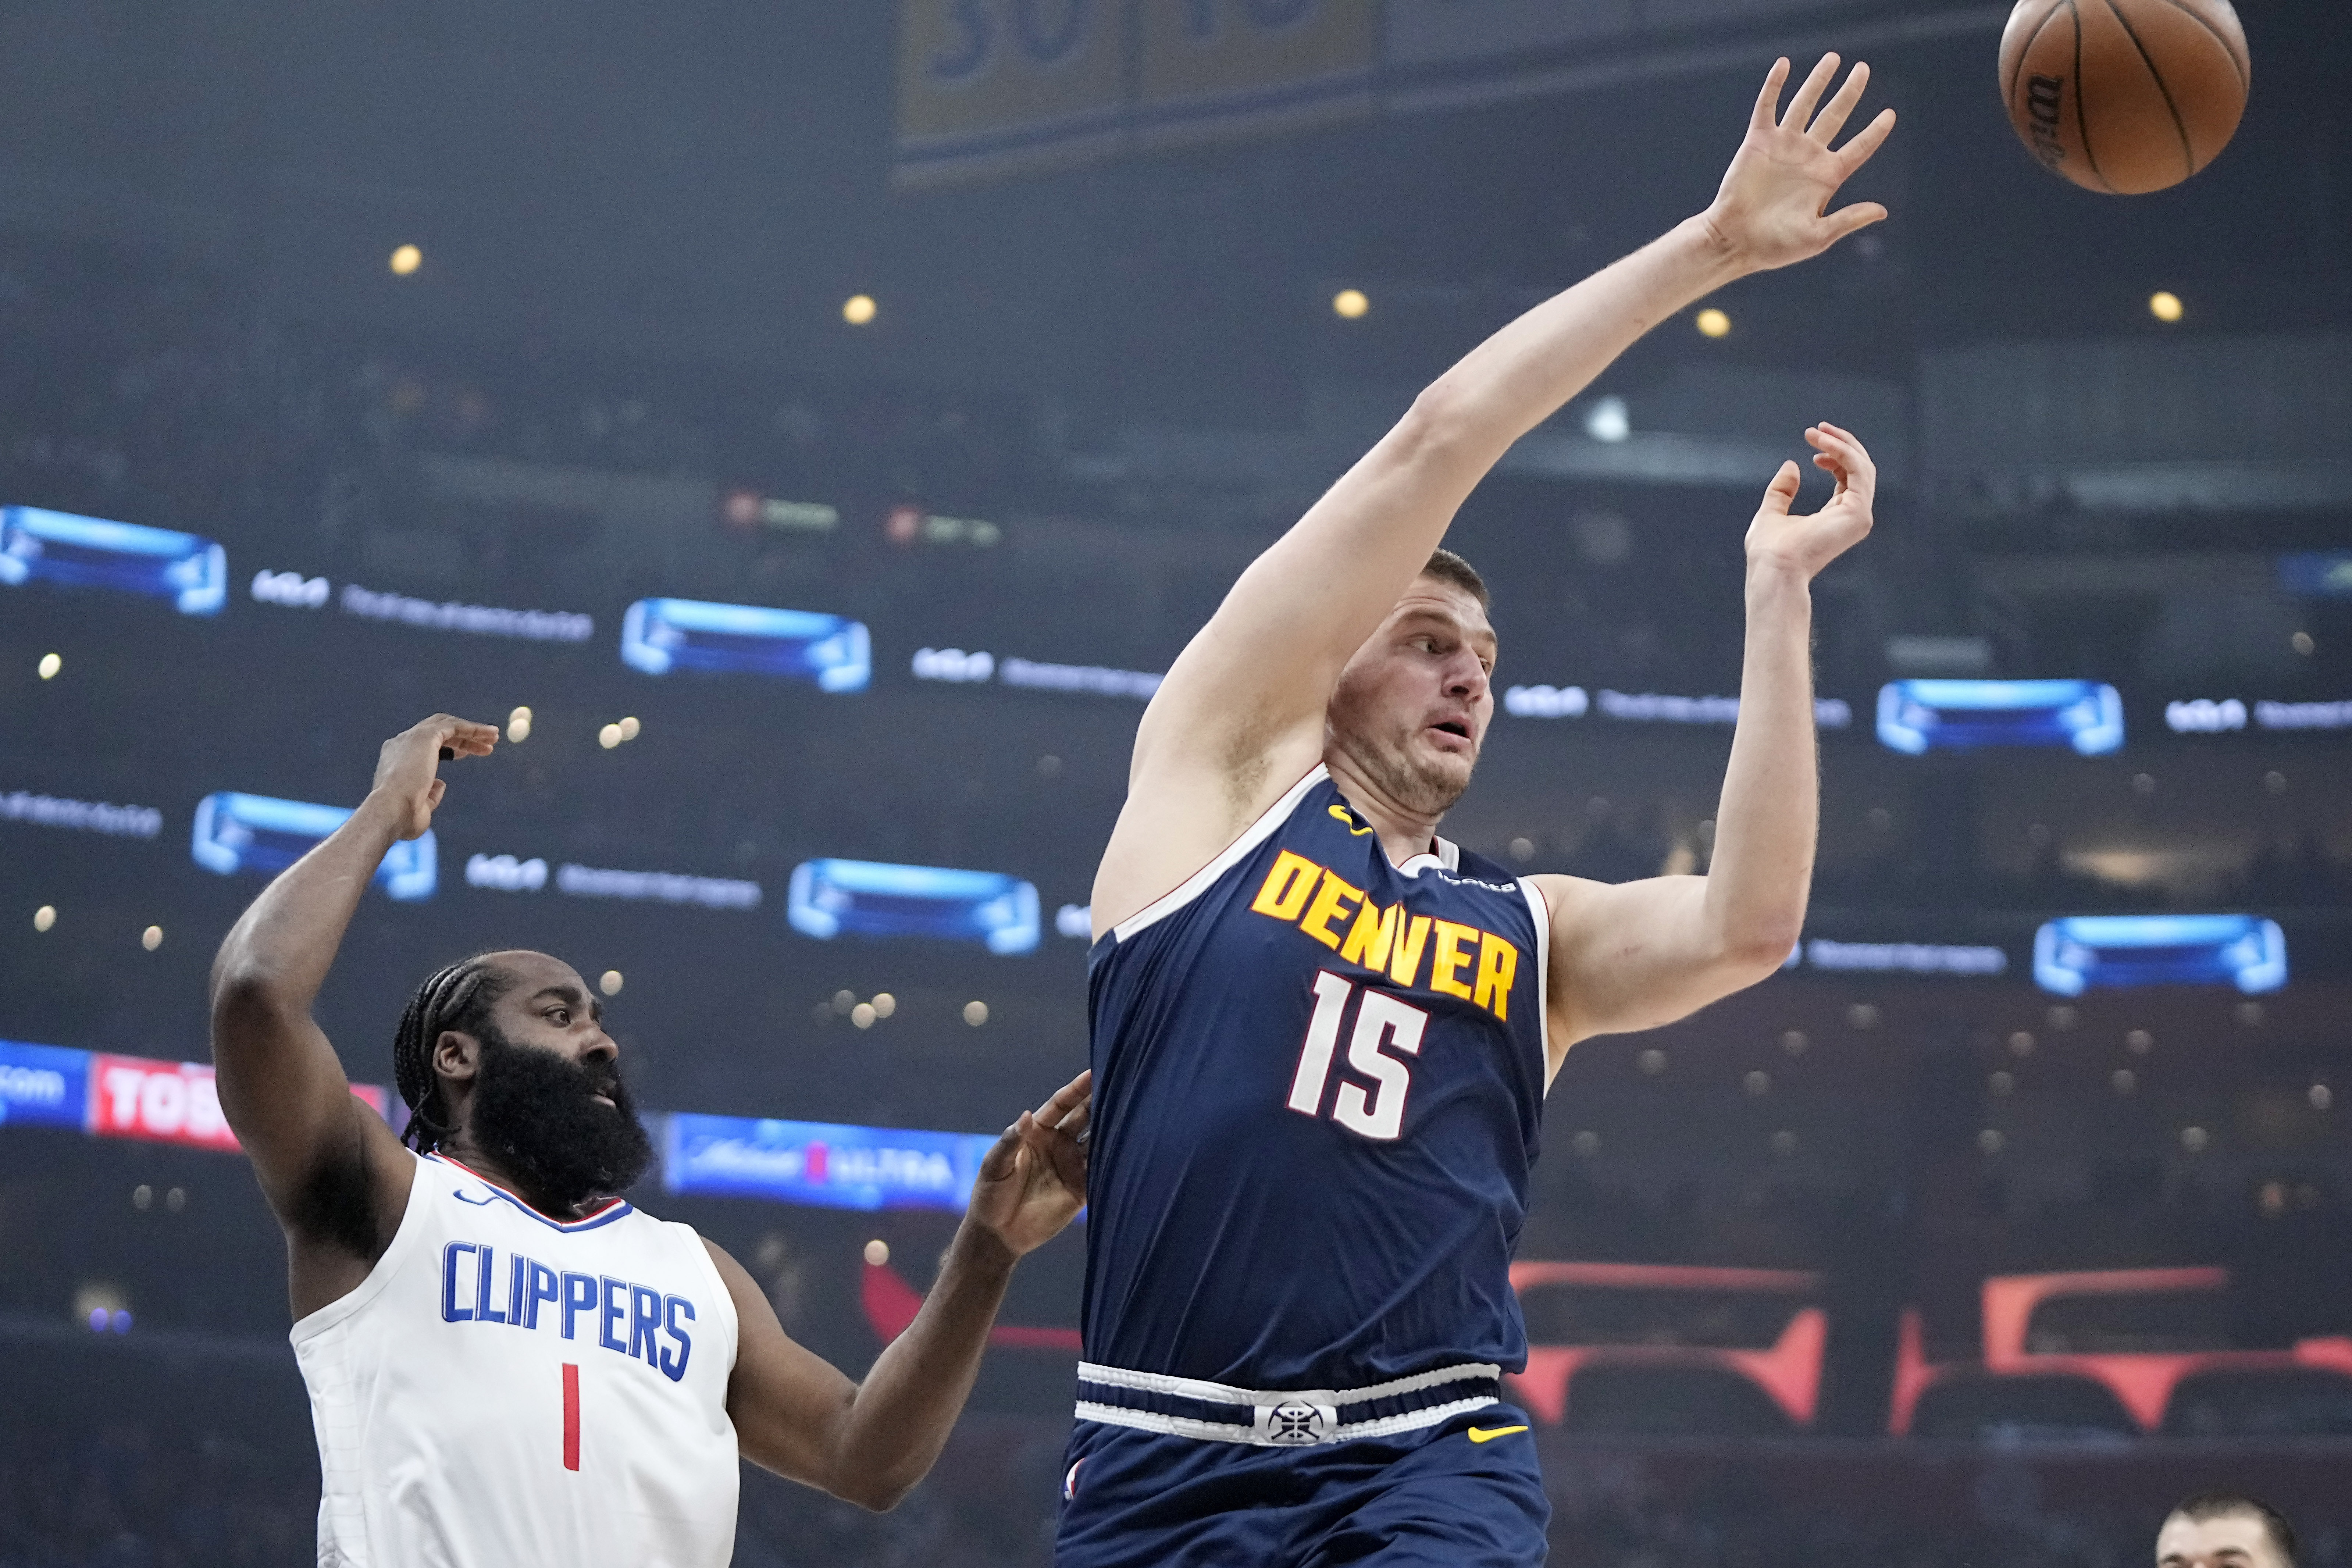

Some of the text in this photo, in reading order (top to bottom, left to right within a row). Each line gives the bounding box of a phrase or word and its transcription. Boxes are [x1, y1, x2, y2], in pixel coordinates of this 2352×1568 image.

[1251, 849, 1518, 1022] DENVER
[1286, 968, 1431, 1140] 15
[442, 1240, 696, 1382] CLIPPERS
[561, 1362, 580, 1471] 1
